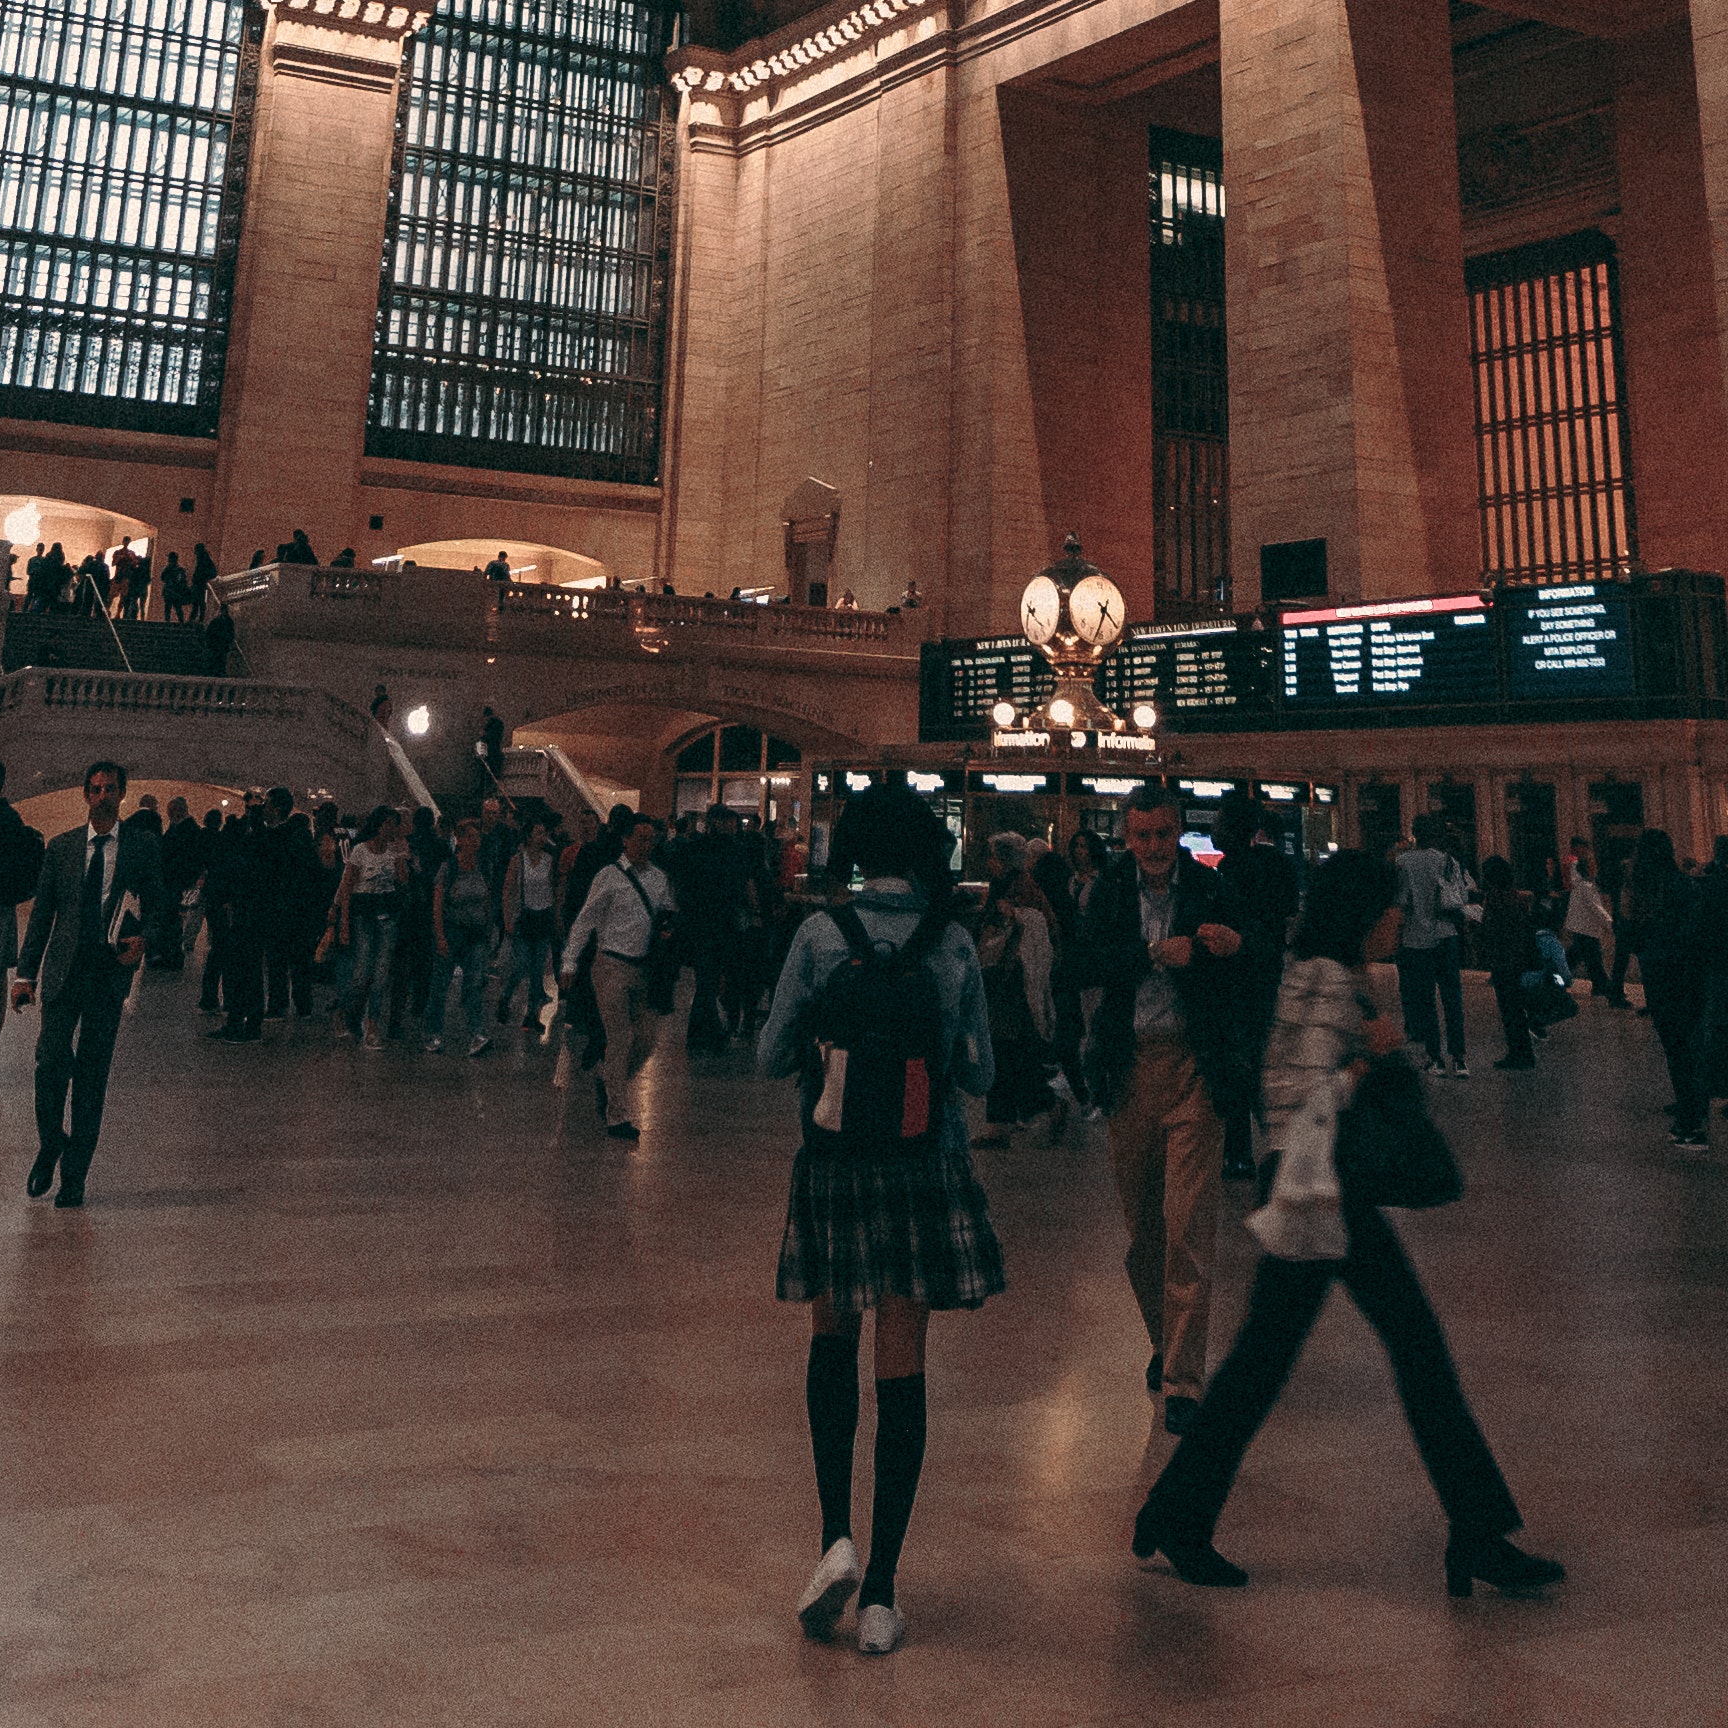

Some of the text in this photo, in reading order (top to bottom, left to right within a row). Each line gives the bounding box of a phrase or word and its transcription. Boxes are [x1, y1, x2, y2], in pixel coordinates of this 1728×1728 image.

[1538, 585, 1595, 600] INFORMATION
[1535, 608, 1550, 618] YOU
[1551, 607, 1564, 617] SEE
[1540, 618, 1596, 631] SAY SOMETHING
[1522, 635, 1544, 645] ALERT
[1550, 633, 1573, 643] POLICE
[1574, 631, 1604, 642] OFFICER
[1604, 629, 1617, 640] OR
[1559, 644, 1596, 655] EMPLOYEE
[1535, 660, 1547, 670] OR
[1546, 659, 1564, 669] CALL
